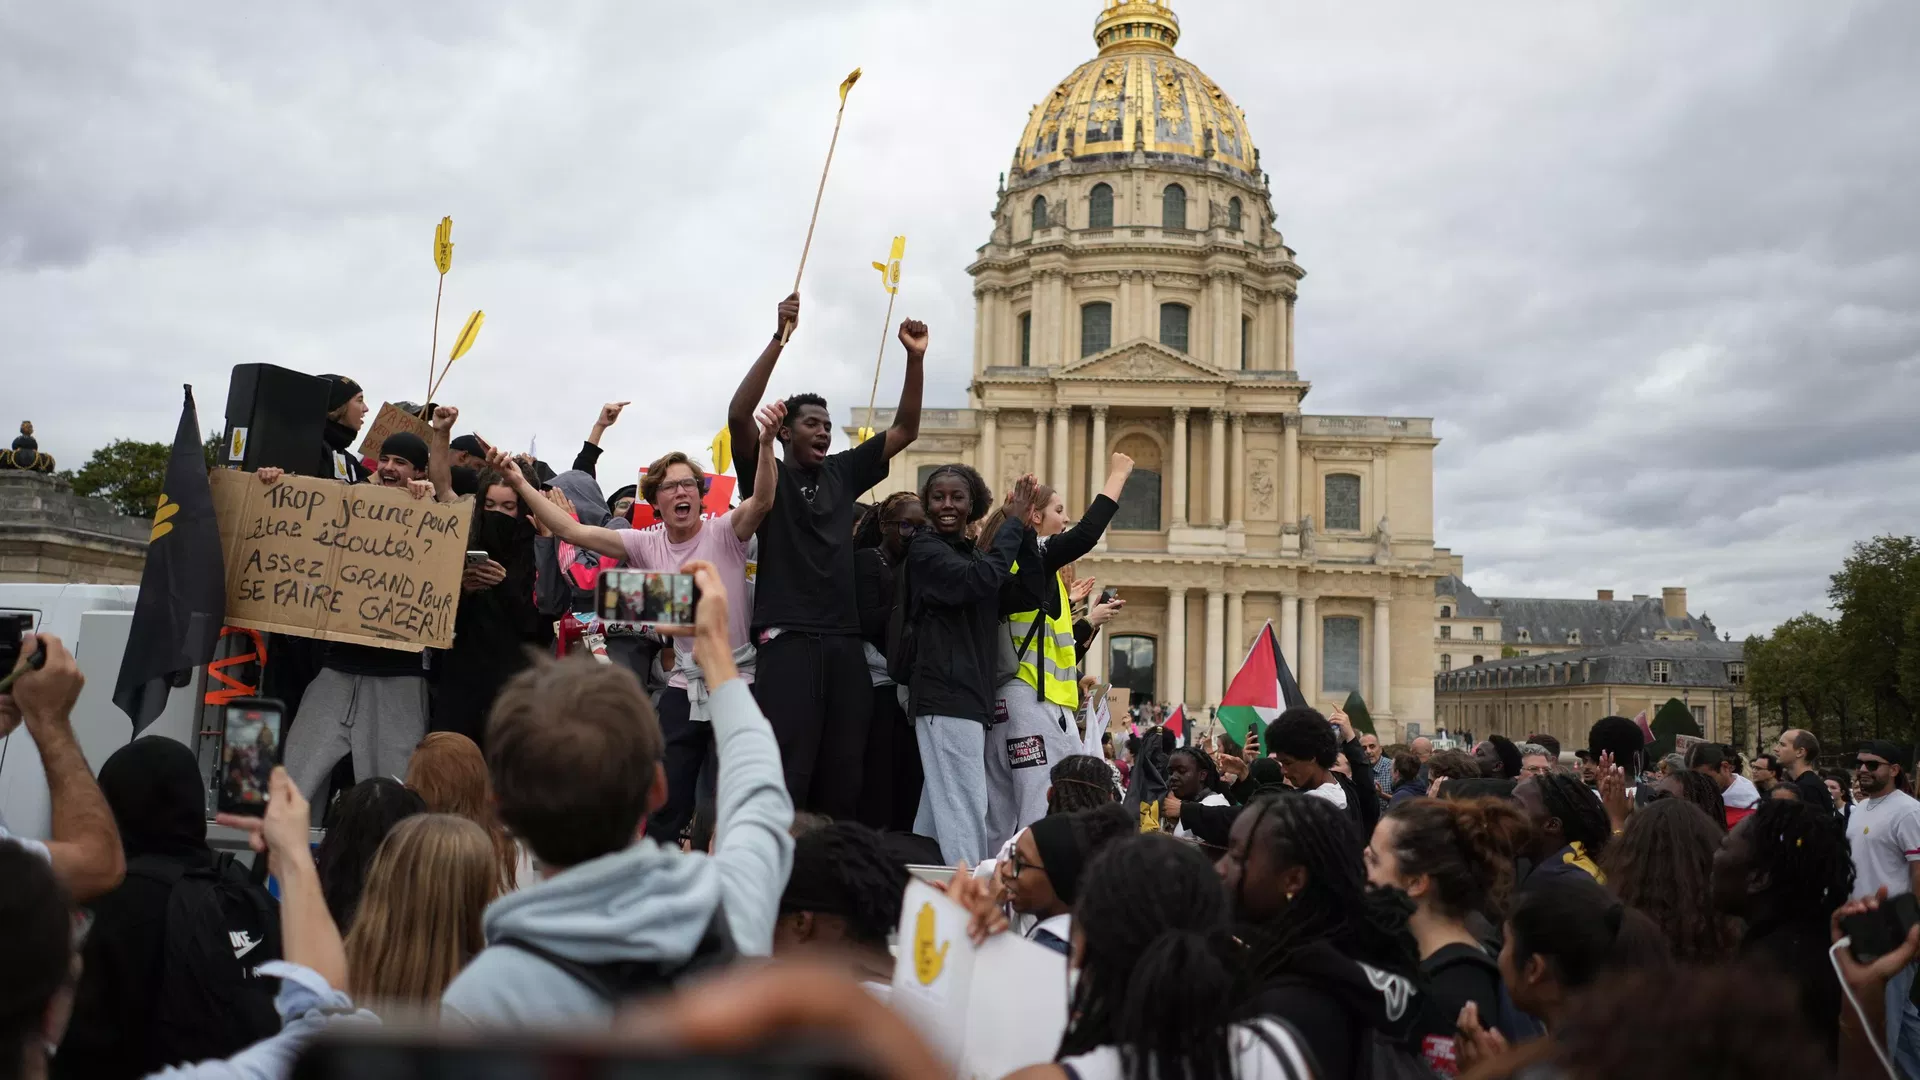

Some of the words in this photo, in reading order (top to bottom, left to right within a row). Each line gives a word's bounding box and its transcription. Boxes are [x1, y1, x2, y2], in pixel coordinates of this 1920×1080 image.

[264, 482, 325, 520] TROP
[238, 579, 265, 601] SE
[340, 565, 415, 599] GRAND
[1017, 748, 1028, 757] PAS
